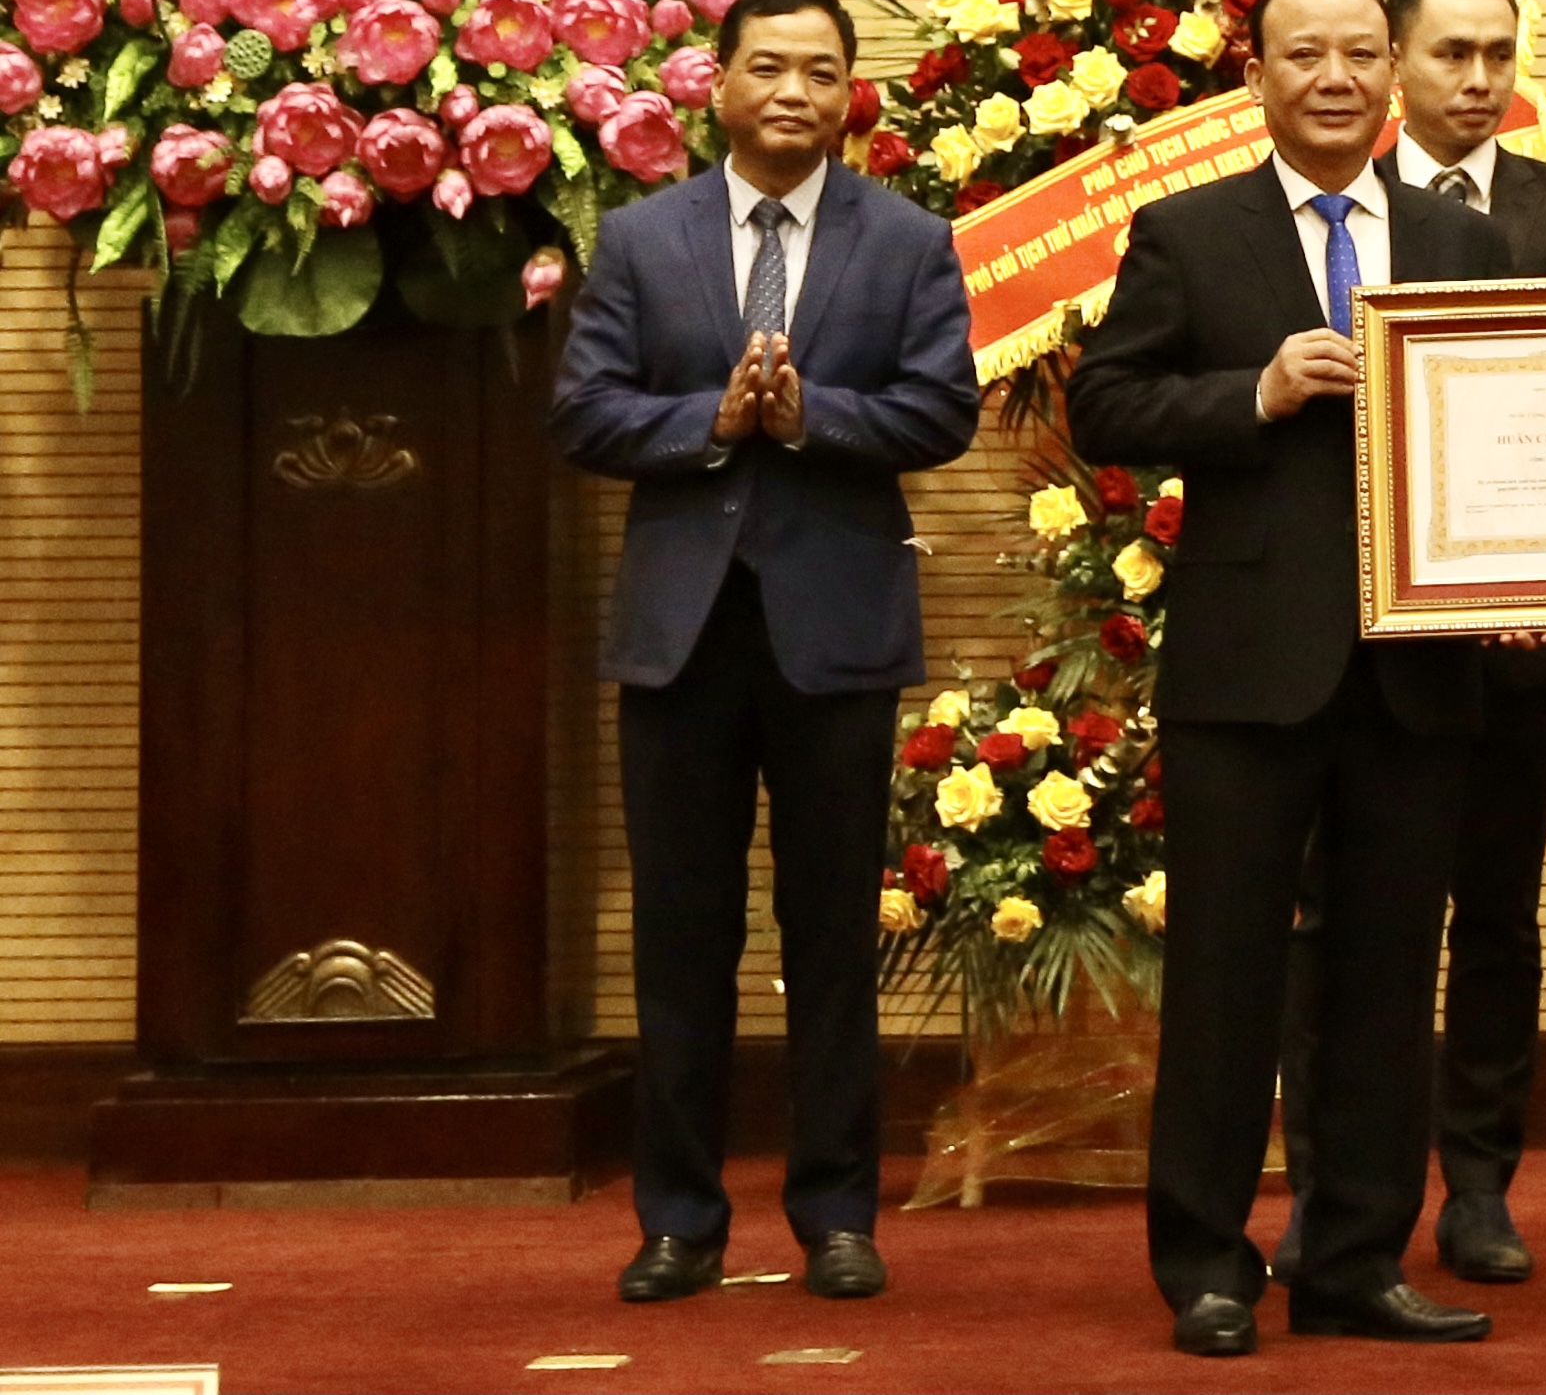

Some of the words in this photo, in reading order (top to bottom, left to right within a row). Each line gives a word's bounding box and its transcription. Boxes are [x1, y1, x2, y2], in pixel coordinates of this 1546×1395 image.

[1114, 143, 1149, 187] CHỦ
[1146, 134, 1186, 166] TỊCH
[991, 244, 1019, 282] CHỦ
[1014, 238, 1048, 270] TỊCH
[1163, 170, 1190, 194] THI
[1214, 147, 1255, 178] KHEN
